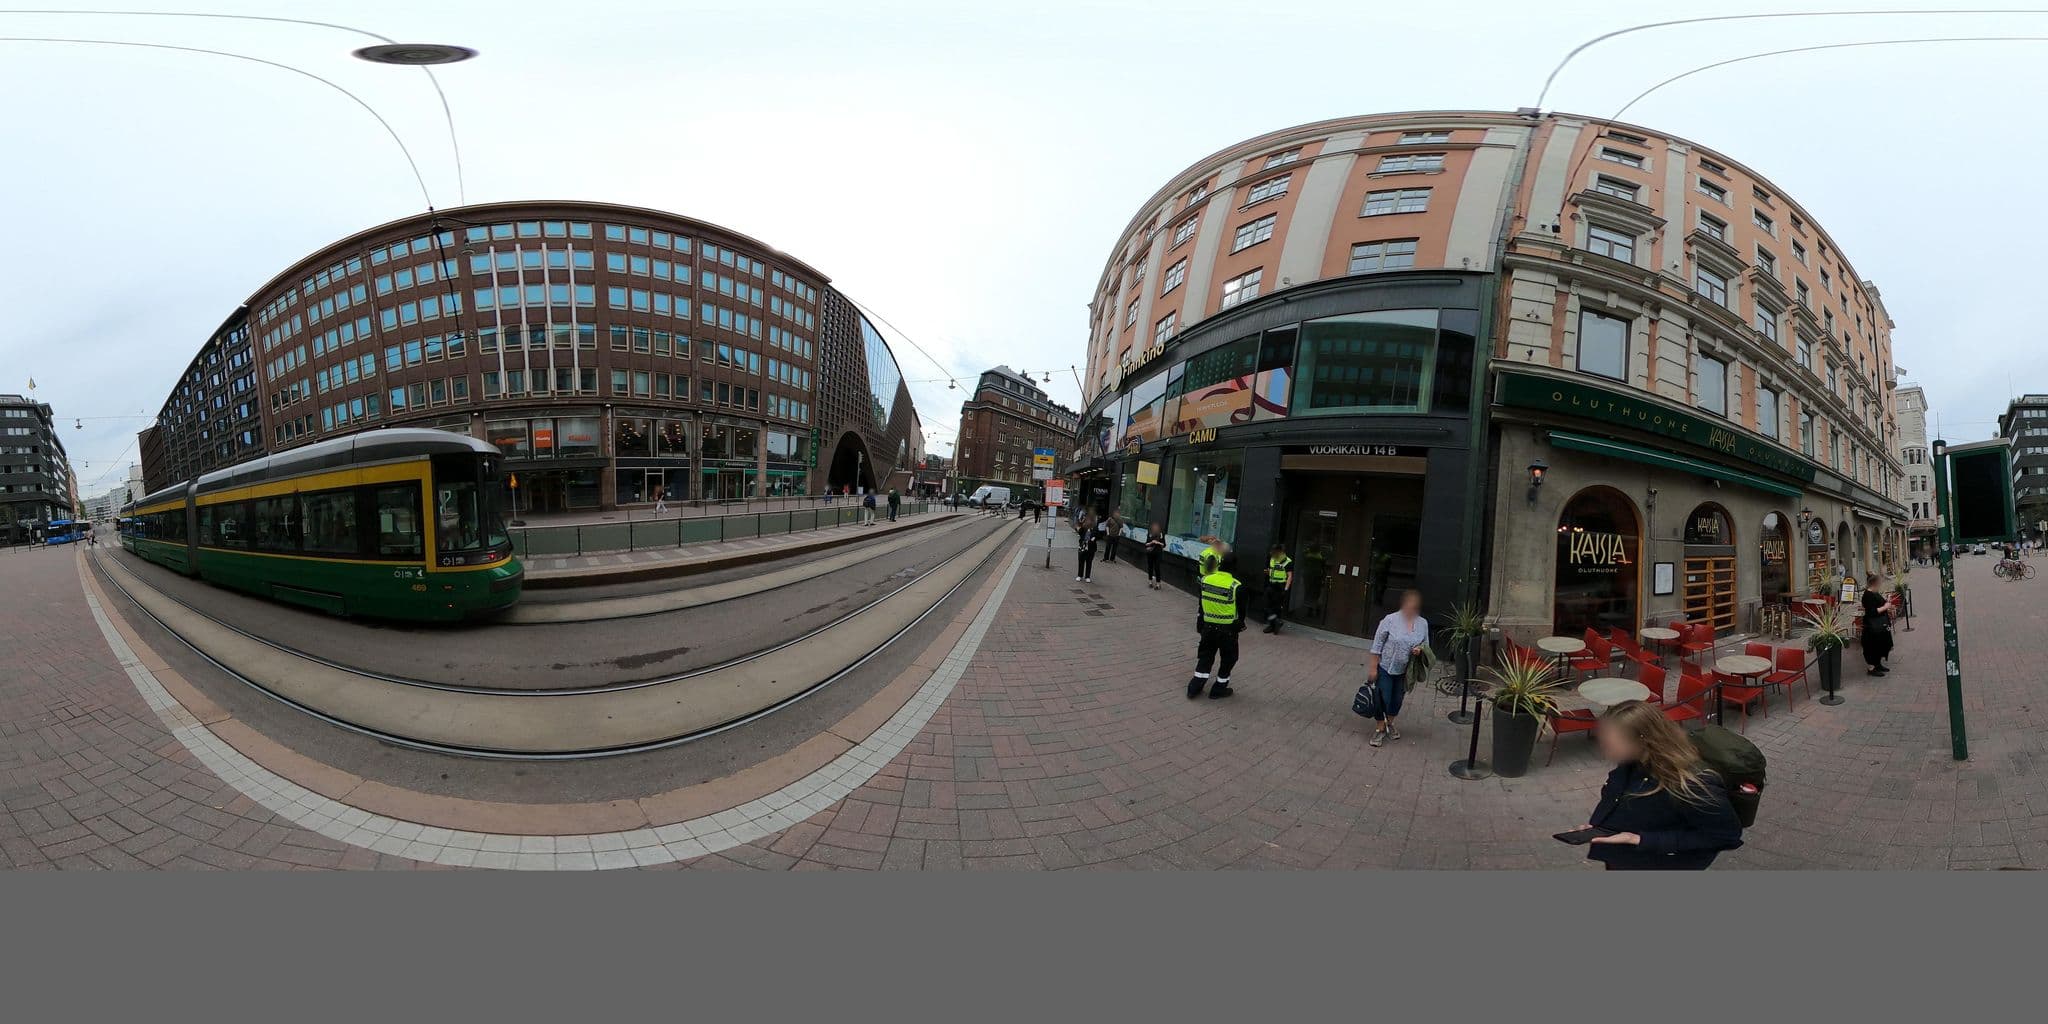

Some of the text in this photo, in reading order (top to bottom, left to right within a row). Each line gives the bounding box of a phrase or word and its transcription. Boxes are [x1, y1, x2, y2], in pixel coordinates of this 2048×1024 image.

[1122, 342, 1165, 380] Finnkino
[1551, 391, 1688, 433] OLUTHUONE
[1189, 427, 1217, 445] CAMU
[1709, 427, 1737, 453] KAISLA
[1309, 445, 1396, 456] VUORIKATU 14 B
[1697, 517, 1720, 534] KAISLA
[1570, 532, 1626, 564] KAISLA
[1763, 541, 1786, 561] KAISLA
